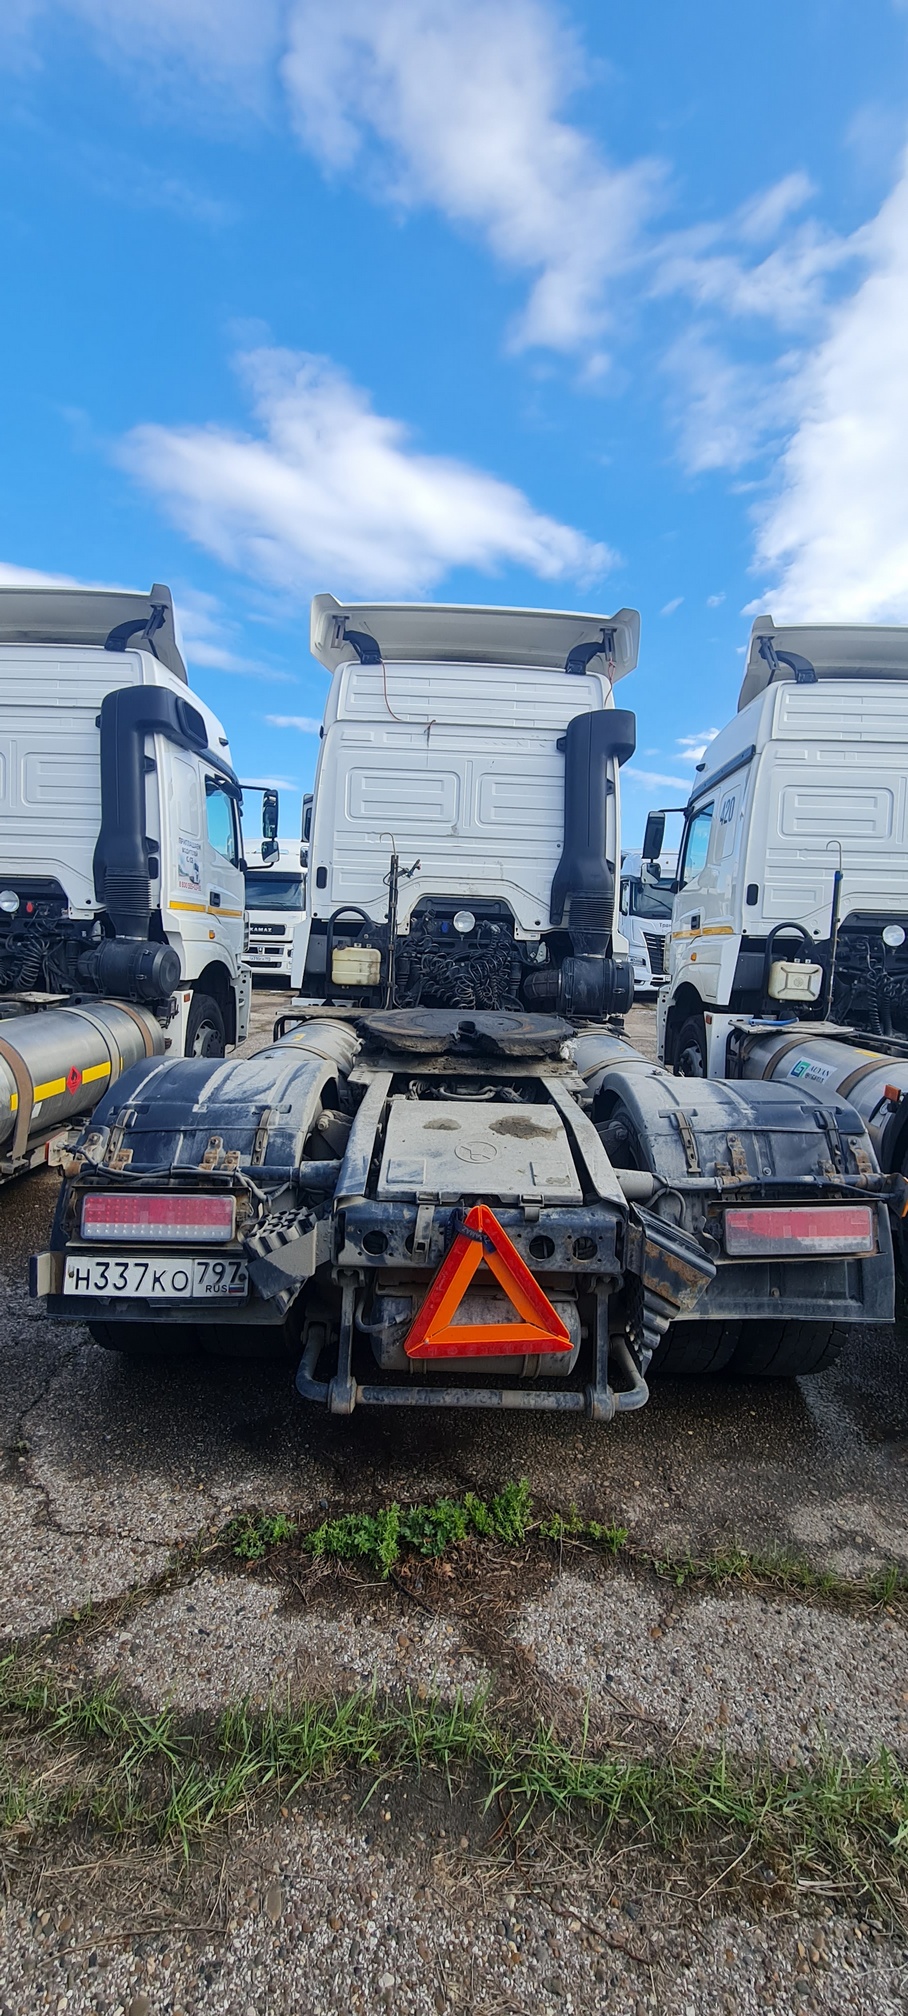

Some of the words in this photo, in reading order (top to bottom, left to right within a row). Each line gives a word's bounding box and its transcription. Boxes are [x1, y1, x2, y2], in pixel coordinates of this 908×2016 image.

[720, 796, 736, 825] 420
[197, 1262, 240, 1285] 797
[205, 1284, 228, 1293] RUS
